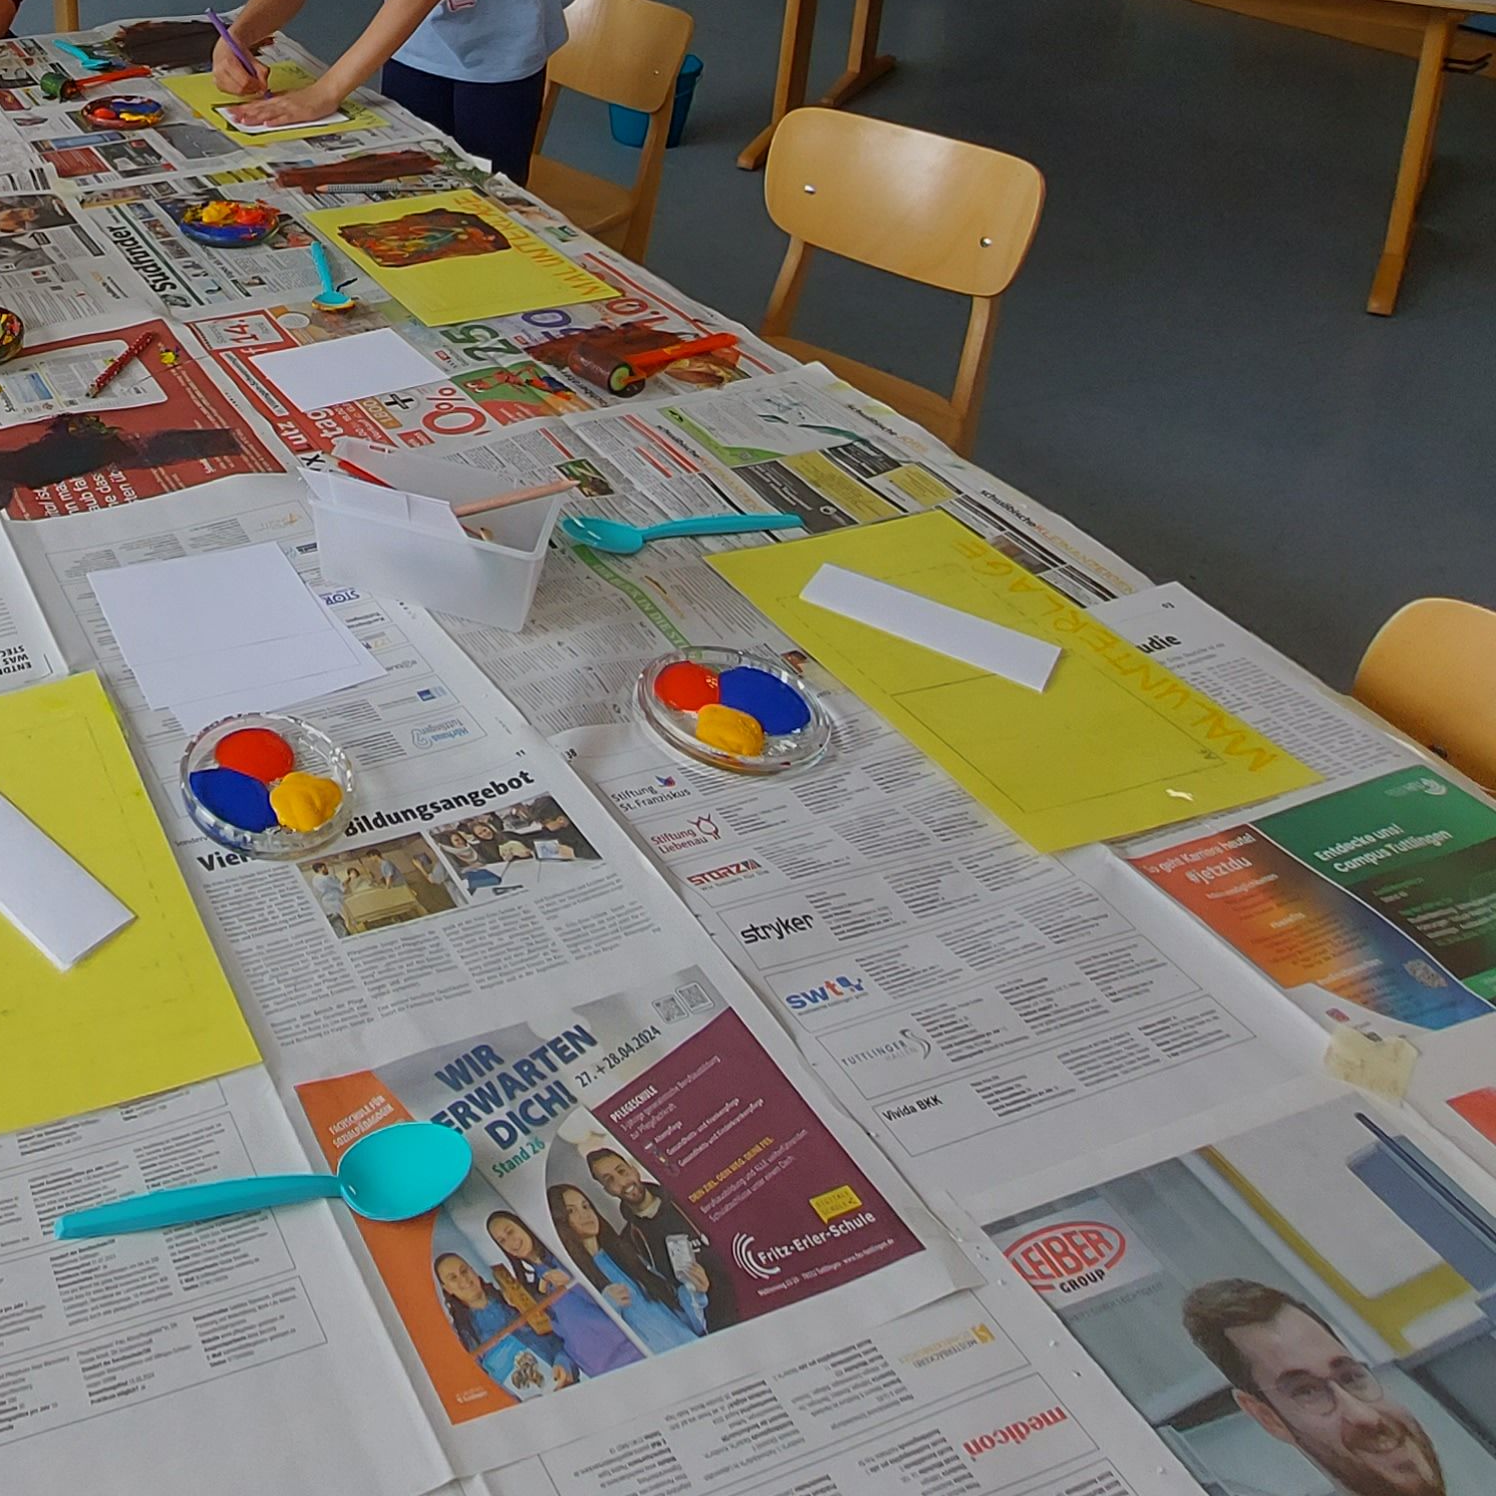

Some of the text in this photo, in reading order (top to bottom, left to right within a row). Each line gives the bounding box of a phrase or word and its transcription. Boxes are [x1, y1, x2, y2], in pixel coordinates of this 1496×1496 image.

[3, 653, 30, 667] WAS
[950, 537, 1281, 773] MALUNTERLAGE
[344, 768, 535, 839] Bildungsangebot
[610, 784, 656, 804] Stiftung
[634, 787, 692, 810] Franziskus
[650, 826, 697, 847] Stiftung
[657, 837, 709, 855] Liebenau
[1333, 828, 1454, 874] Campus Tuttlingen
[740, 912, 814, 945] stryker
[429, 1023, 599, 1135] ERWARTEN
[433, 1043, 506, 1094] WIR
[483, 1078, 580, 1152] DICH!
[882, 1093, 944, 1123] Vivida BKK
[490, 1135, 547, 1180] Stand 26
[1010, 1228, 1114, 1280] LEIBER
[1058, 1267, 1107, 1294] GROUP
[962, 1405, 1069, 1458] medicon
